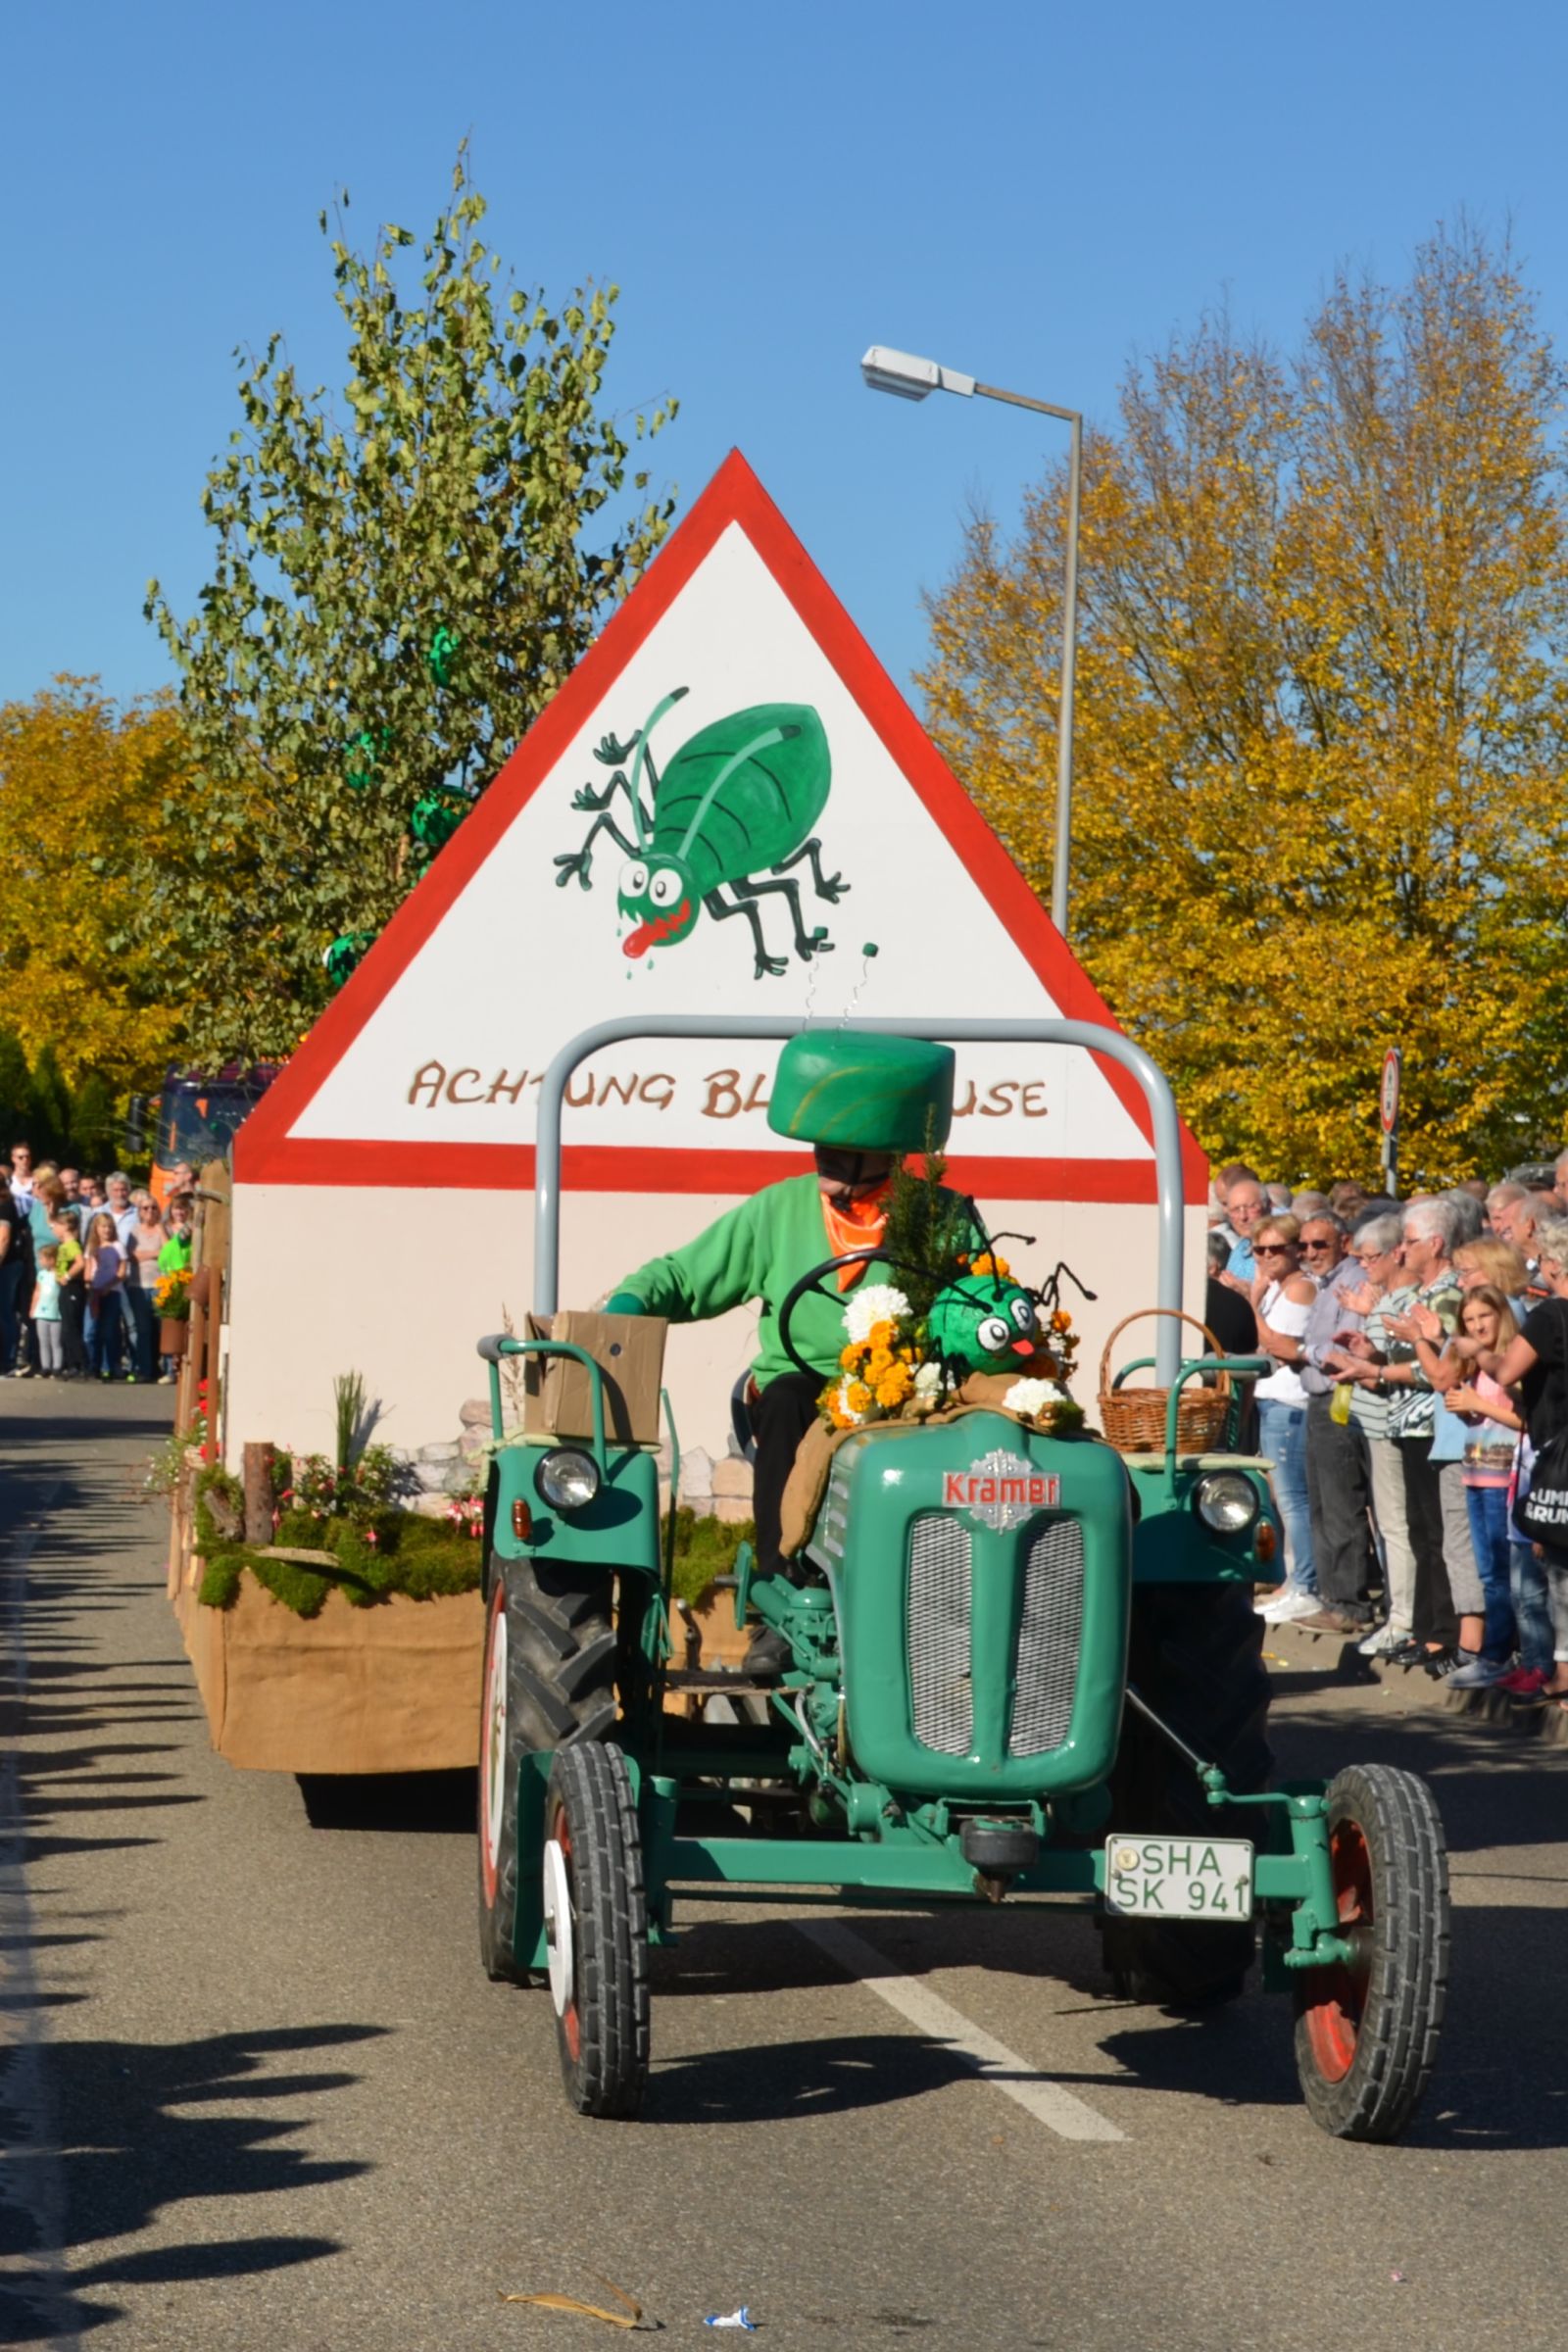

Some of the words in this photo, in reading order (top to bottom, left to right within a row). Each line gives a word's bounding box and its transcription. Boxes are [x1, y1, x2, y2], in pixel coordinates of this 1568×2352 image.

[408, 1059, 676, 1111] ACHUNG
[947, 1473, 1057, 1504] Kramer
[1142, 1843, 1222, 1877] SHA
[1116, 1878, 1165, 1910] SK
[1188, 1881, 1246, 1912] 941
